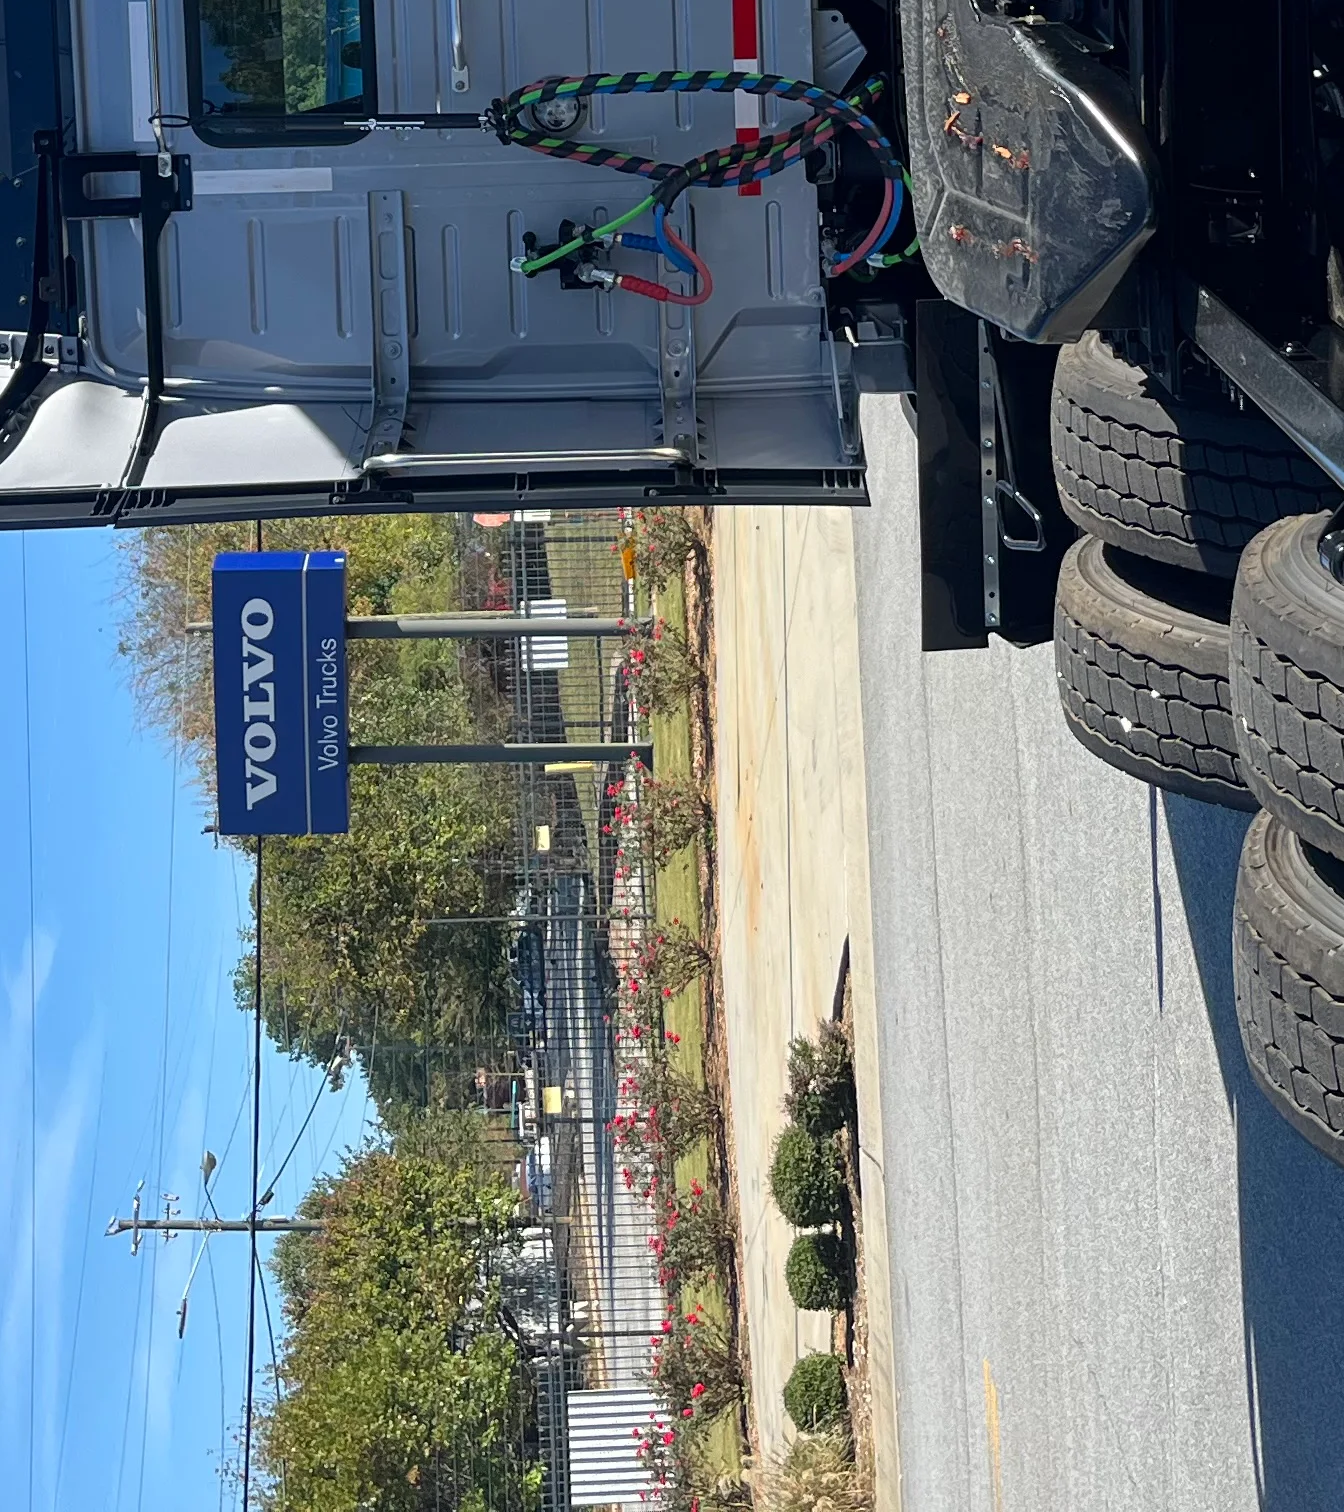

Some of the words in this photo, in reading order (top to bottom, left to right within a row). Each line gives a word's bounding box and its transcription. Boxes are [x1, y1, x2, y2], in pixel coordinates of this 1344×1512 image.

[241, 598, 277, 810] VOLVO
[315, 638, 338, 709] Trucks
[317, 715, 339, 771] Volvo
